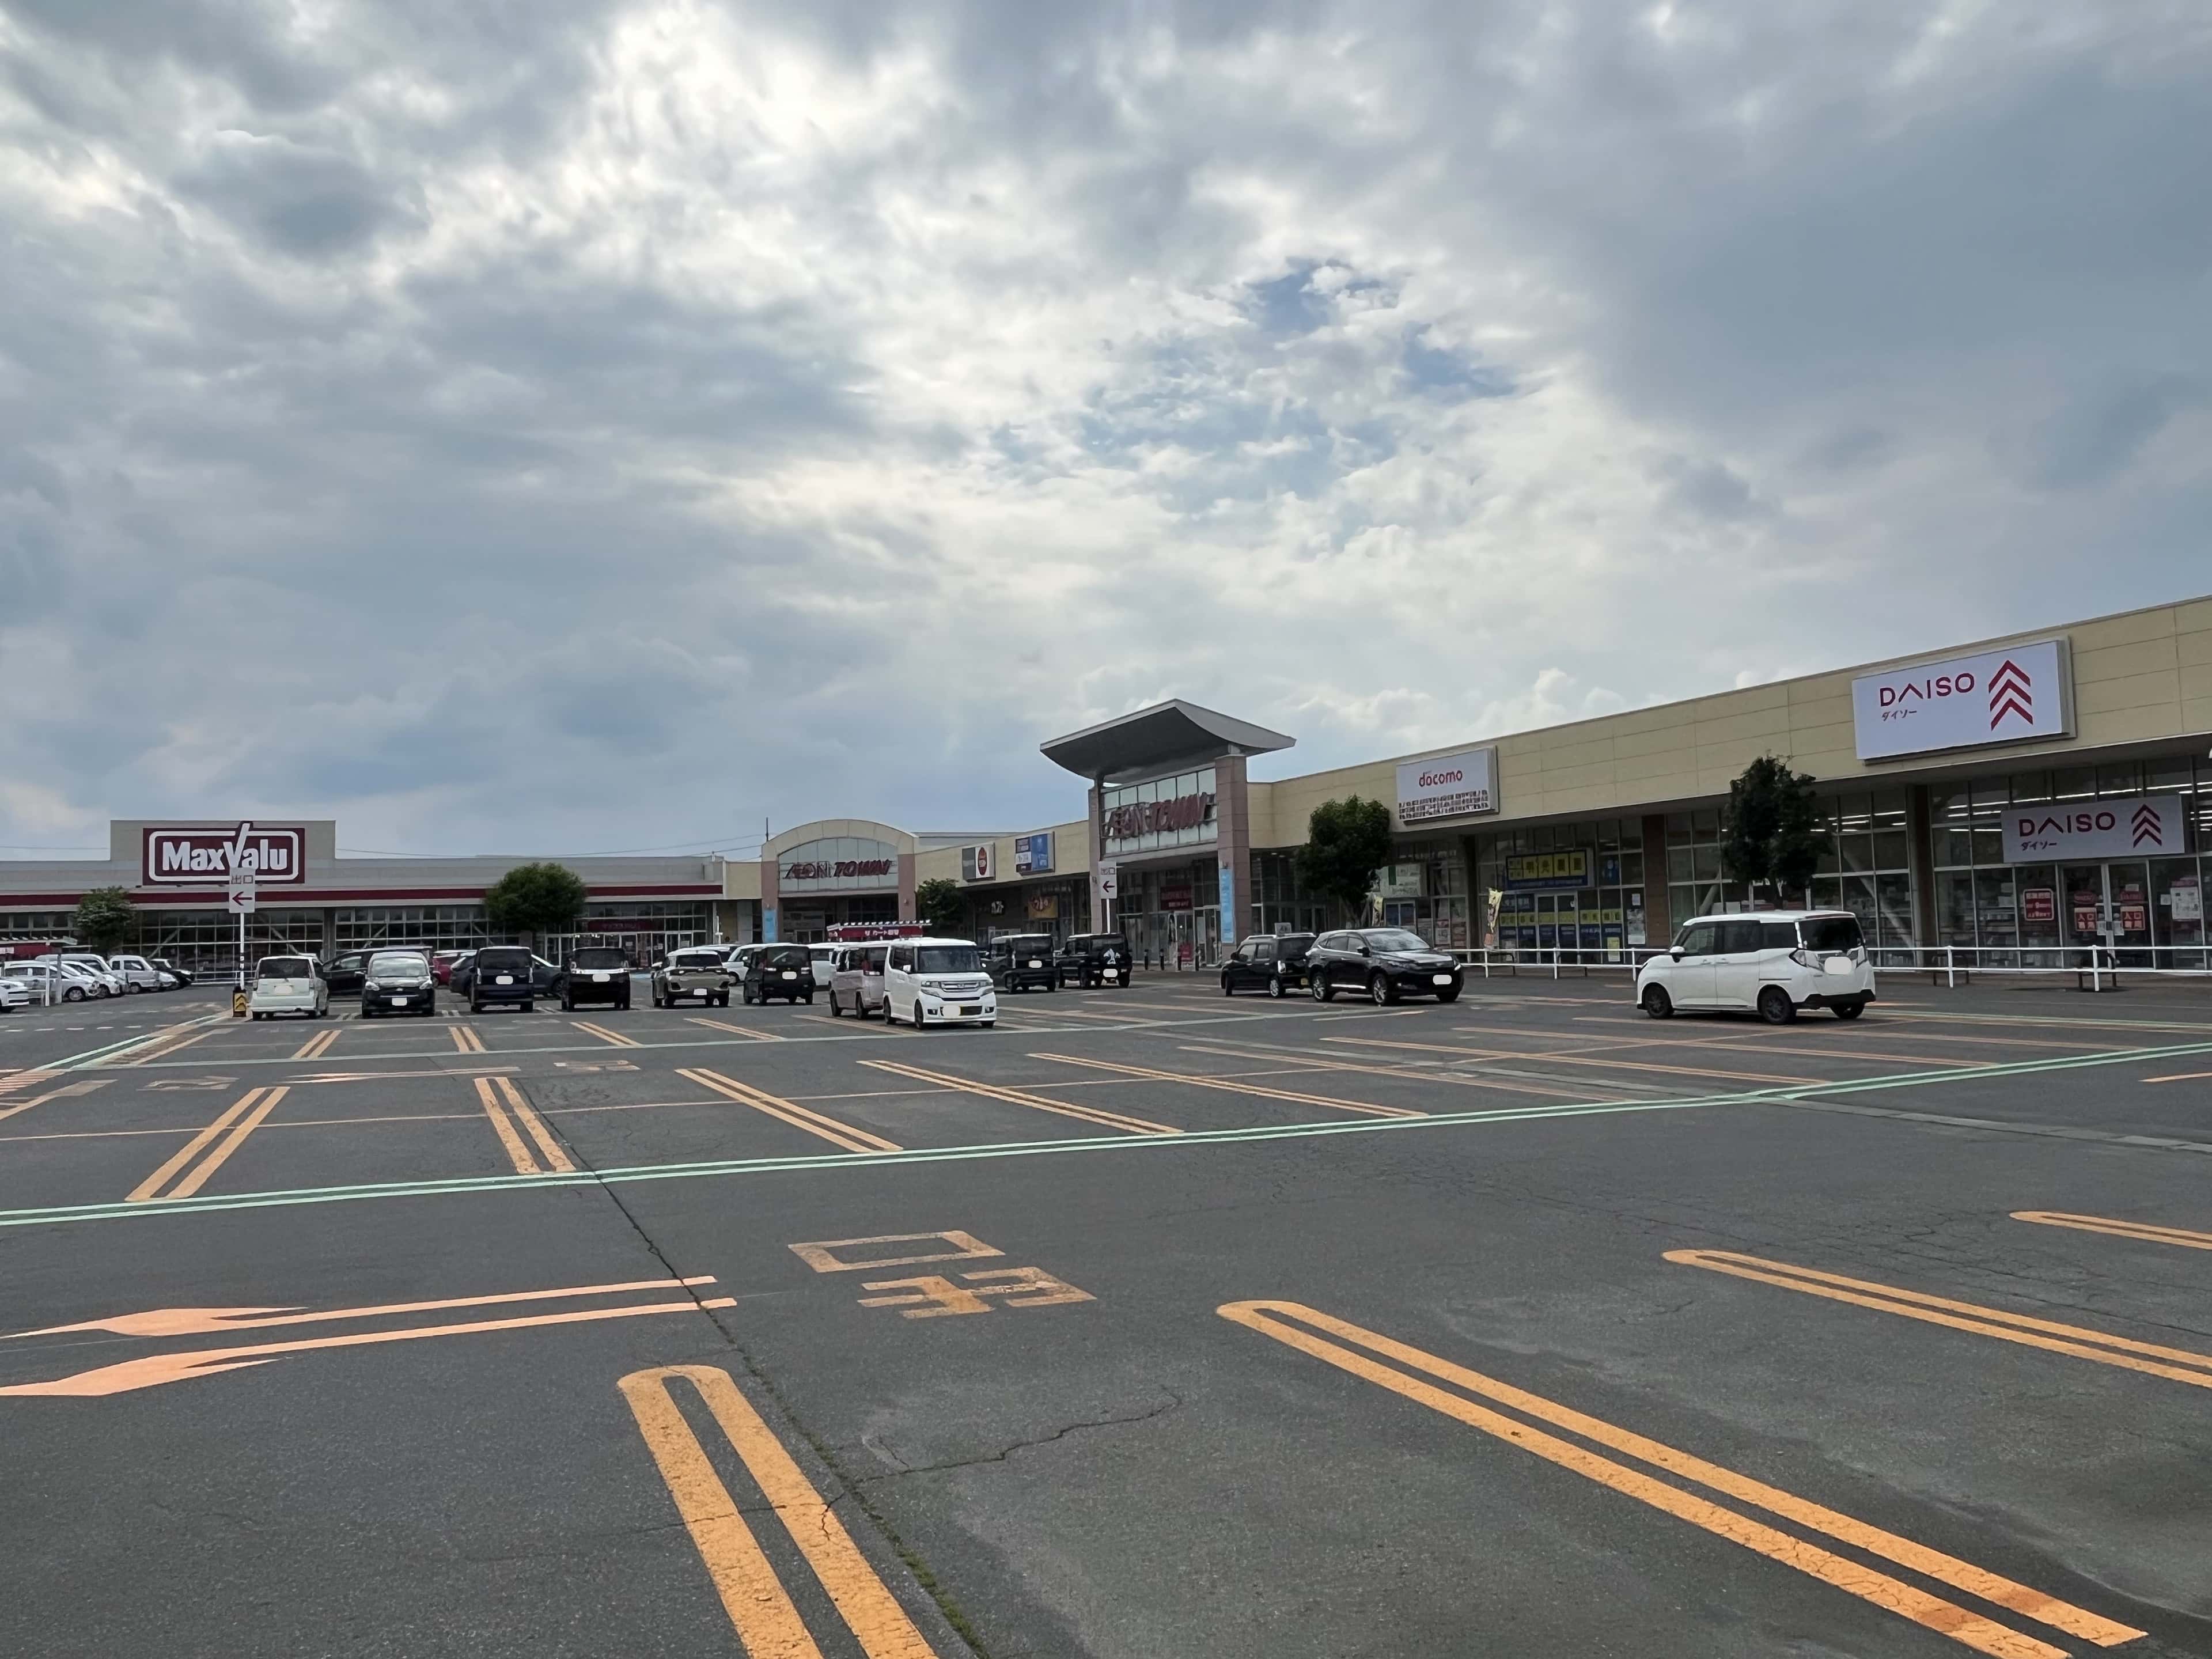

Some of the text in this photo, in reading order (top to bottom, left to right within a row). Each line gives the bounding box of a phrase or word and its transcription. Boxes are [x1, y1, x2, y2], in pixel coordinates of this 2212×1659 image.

[1880, 673, 1975, 706] DAISO
[1881, 709, 1918, 721] ダイソー
[1419, 770, 1463, 787] docomo
[2018, 812, 2116, 837] DAISO
[162, 823, 287, 871] MaxValu
[2021, 840, 2057, 851] ダイソー
[834, 858, 891, 877] TOWN
[231, 874, 253, 885] 出口
